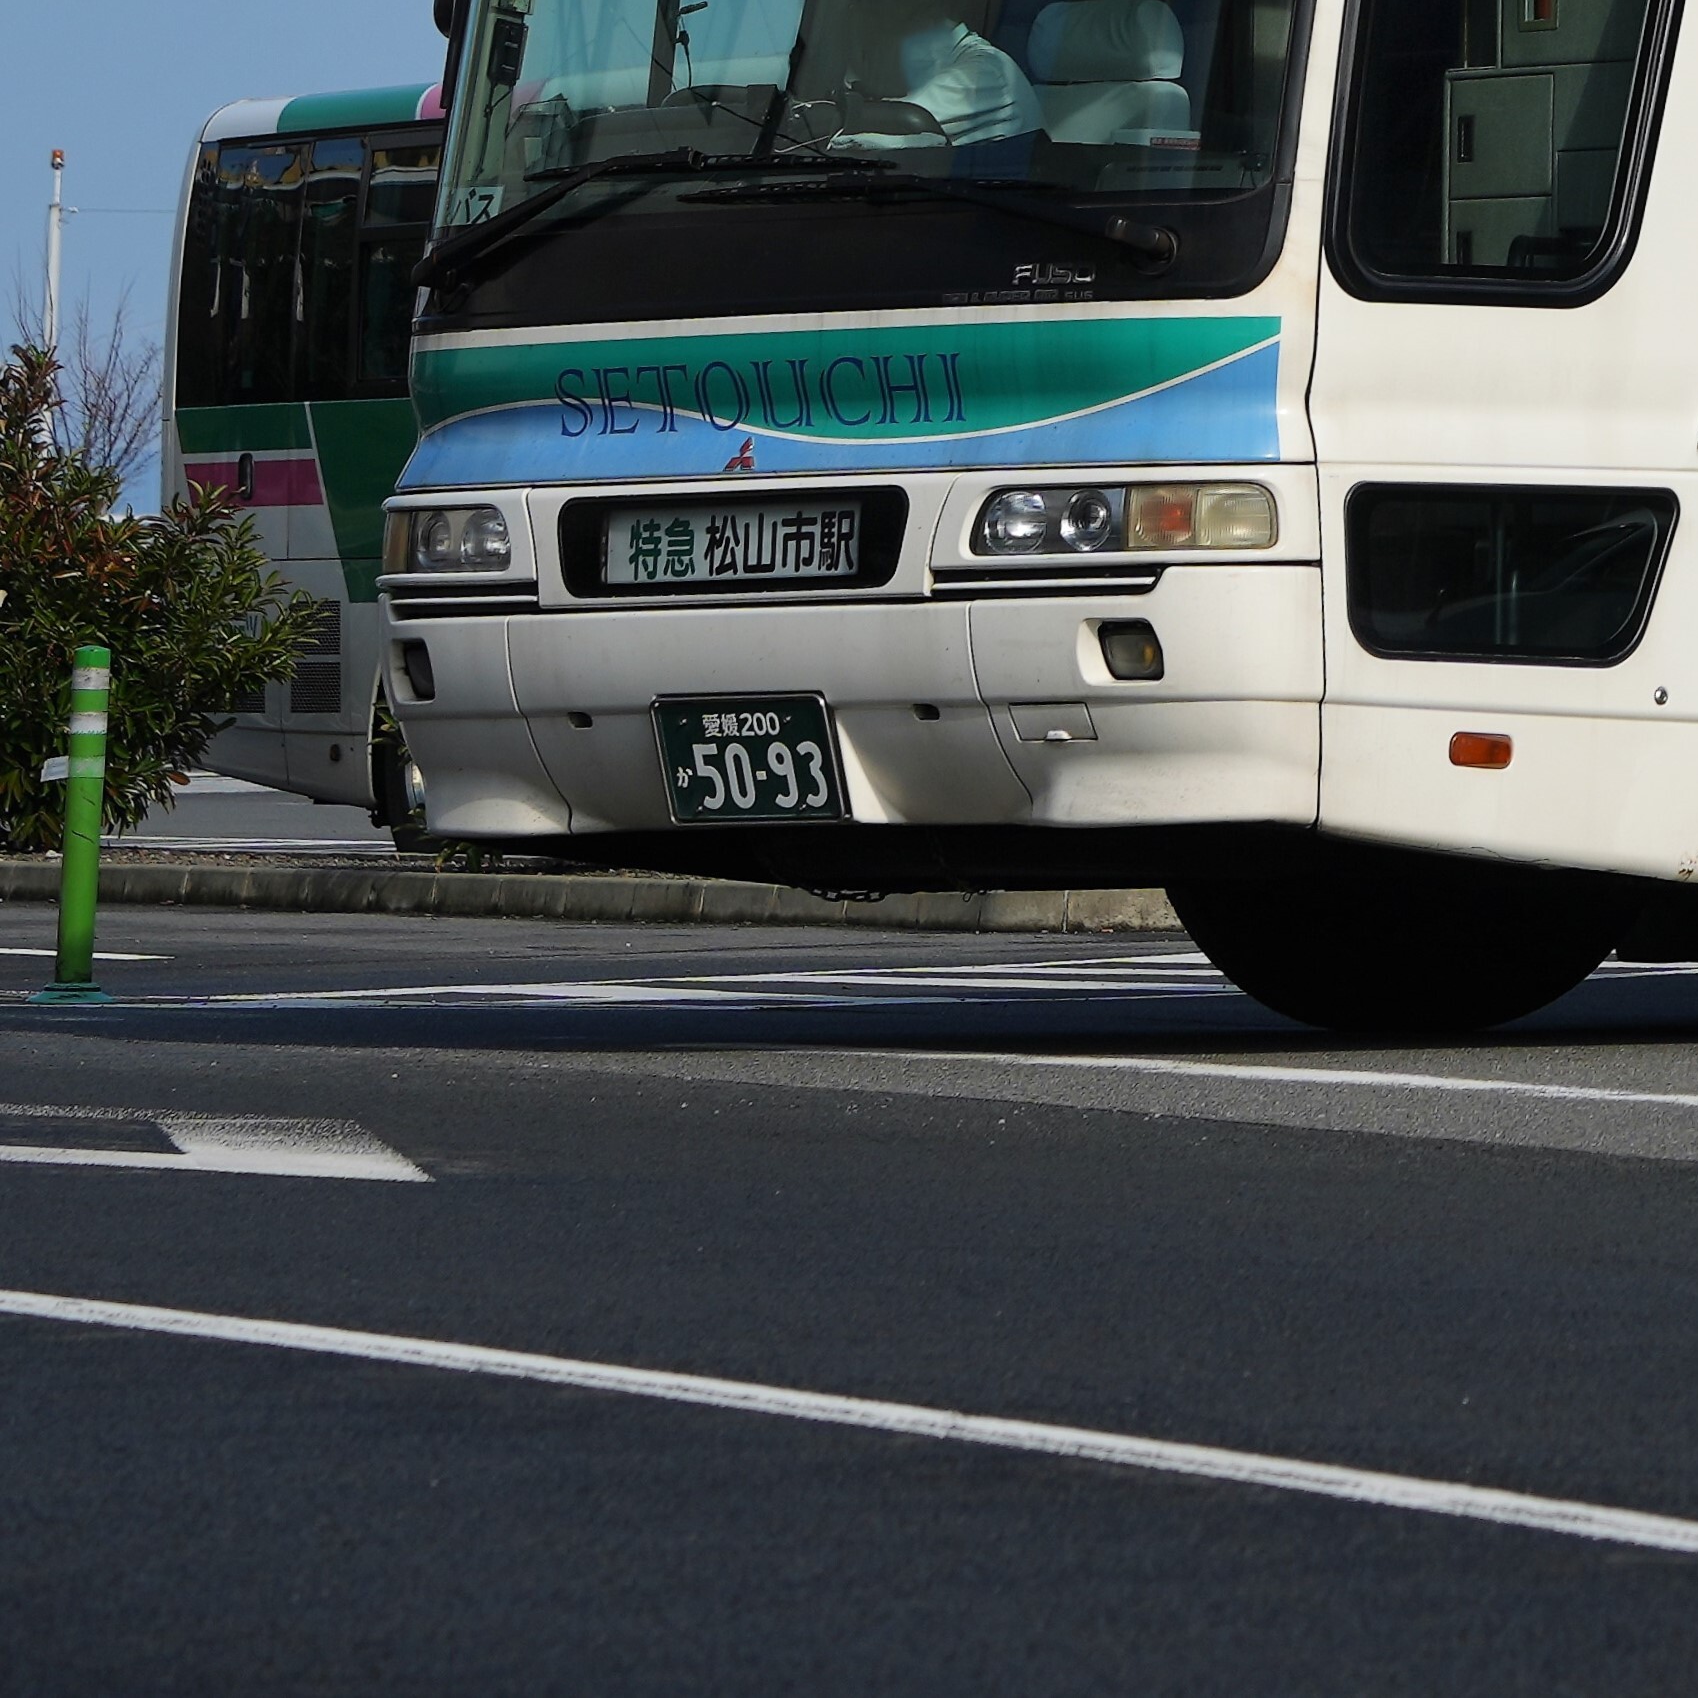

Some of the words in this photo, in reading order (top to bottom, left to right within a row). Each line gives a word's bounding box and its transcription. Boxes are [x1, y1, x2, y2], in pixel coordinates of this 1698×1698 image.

[1012, 263, 1096, 286] FUSO
[555, 352, 968, 438] SETOUCHI
[629, 518, 697, 581] 特急
[704, 509, 855, 577] 松山市駅
[676, 767, 693, 789] か
[692, 740, 829, 810] 50-93
